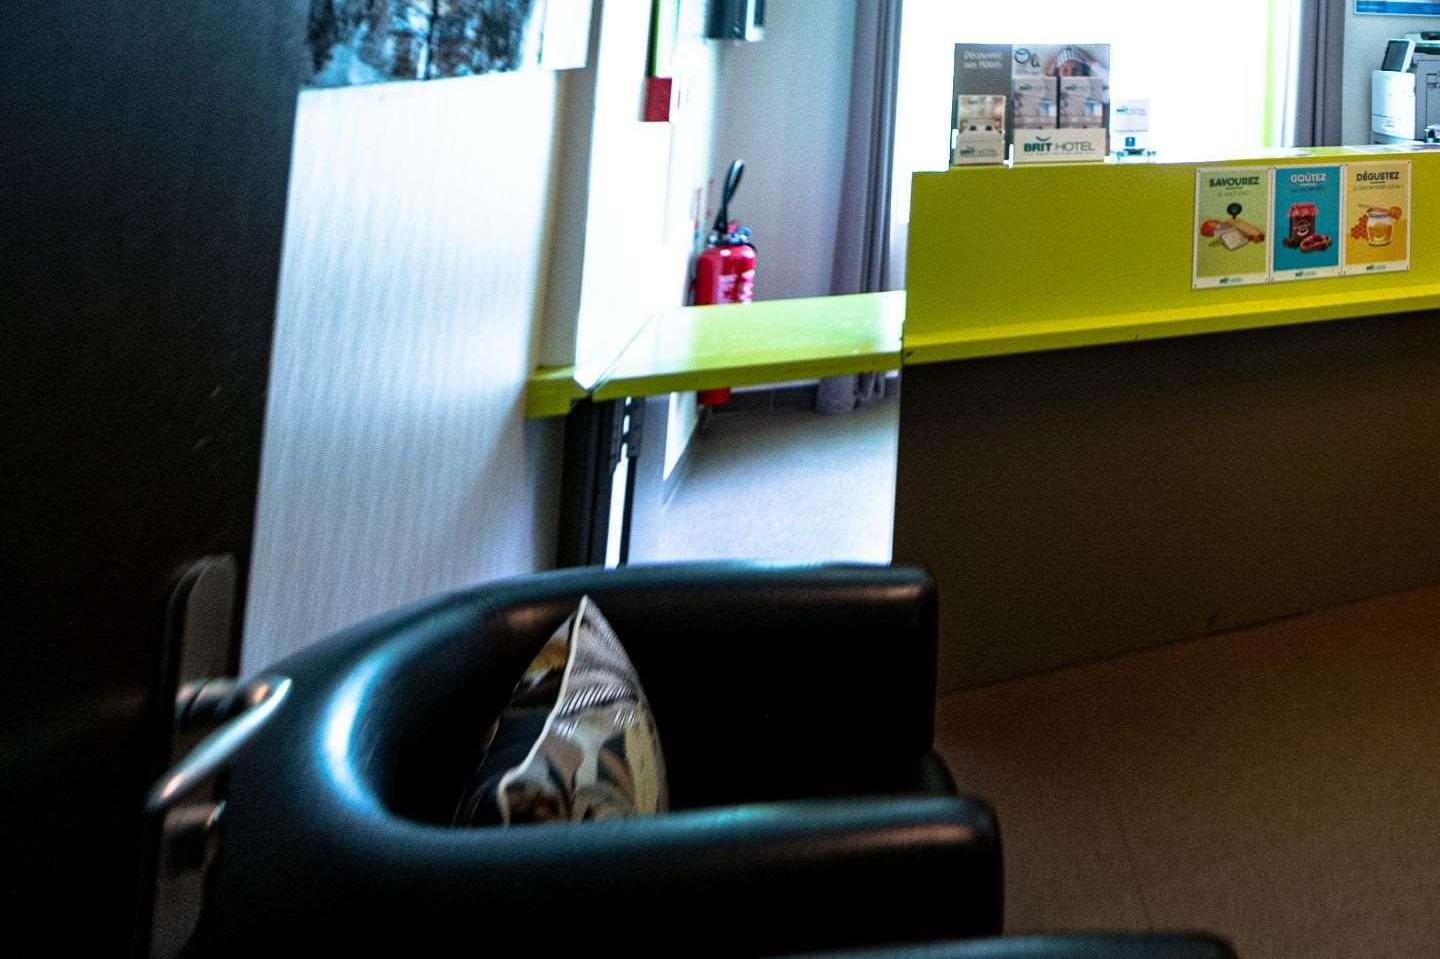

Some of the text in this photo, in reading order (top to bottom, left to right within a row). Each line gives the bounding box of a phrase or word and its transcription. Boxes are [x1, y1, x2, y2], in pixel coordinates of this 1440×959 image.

[1024, 142, 1096, 152] BRIT HOTEL
[1209, 176, 1260, 188] SAVOUREZ
[1356, 170, 1400, 182] DÉGUSTEZ
